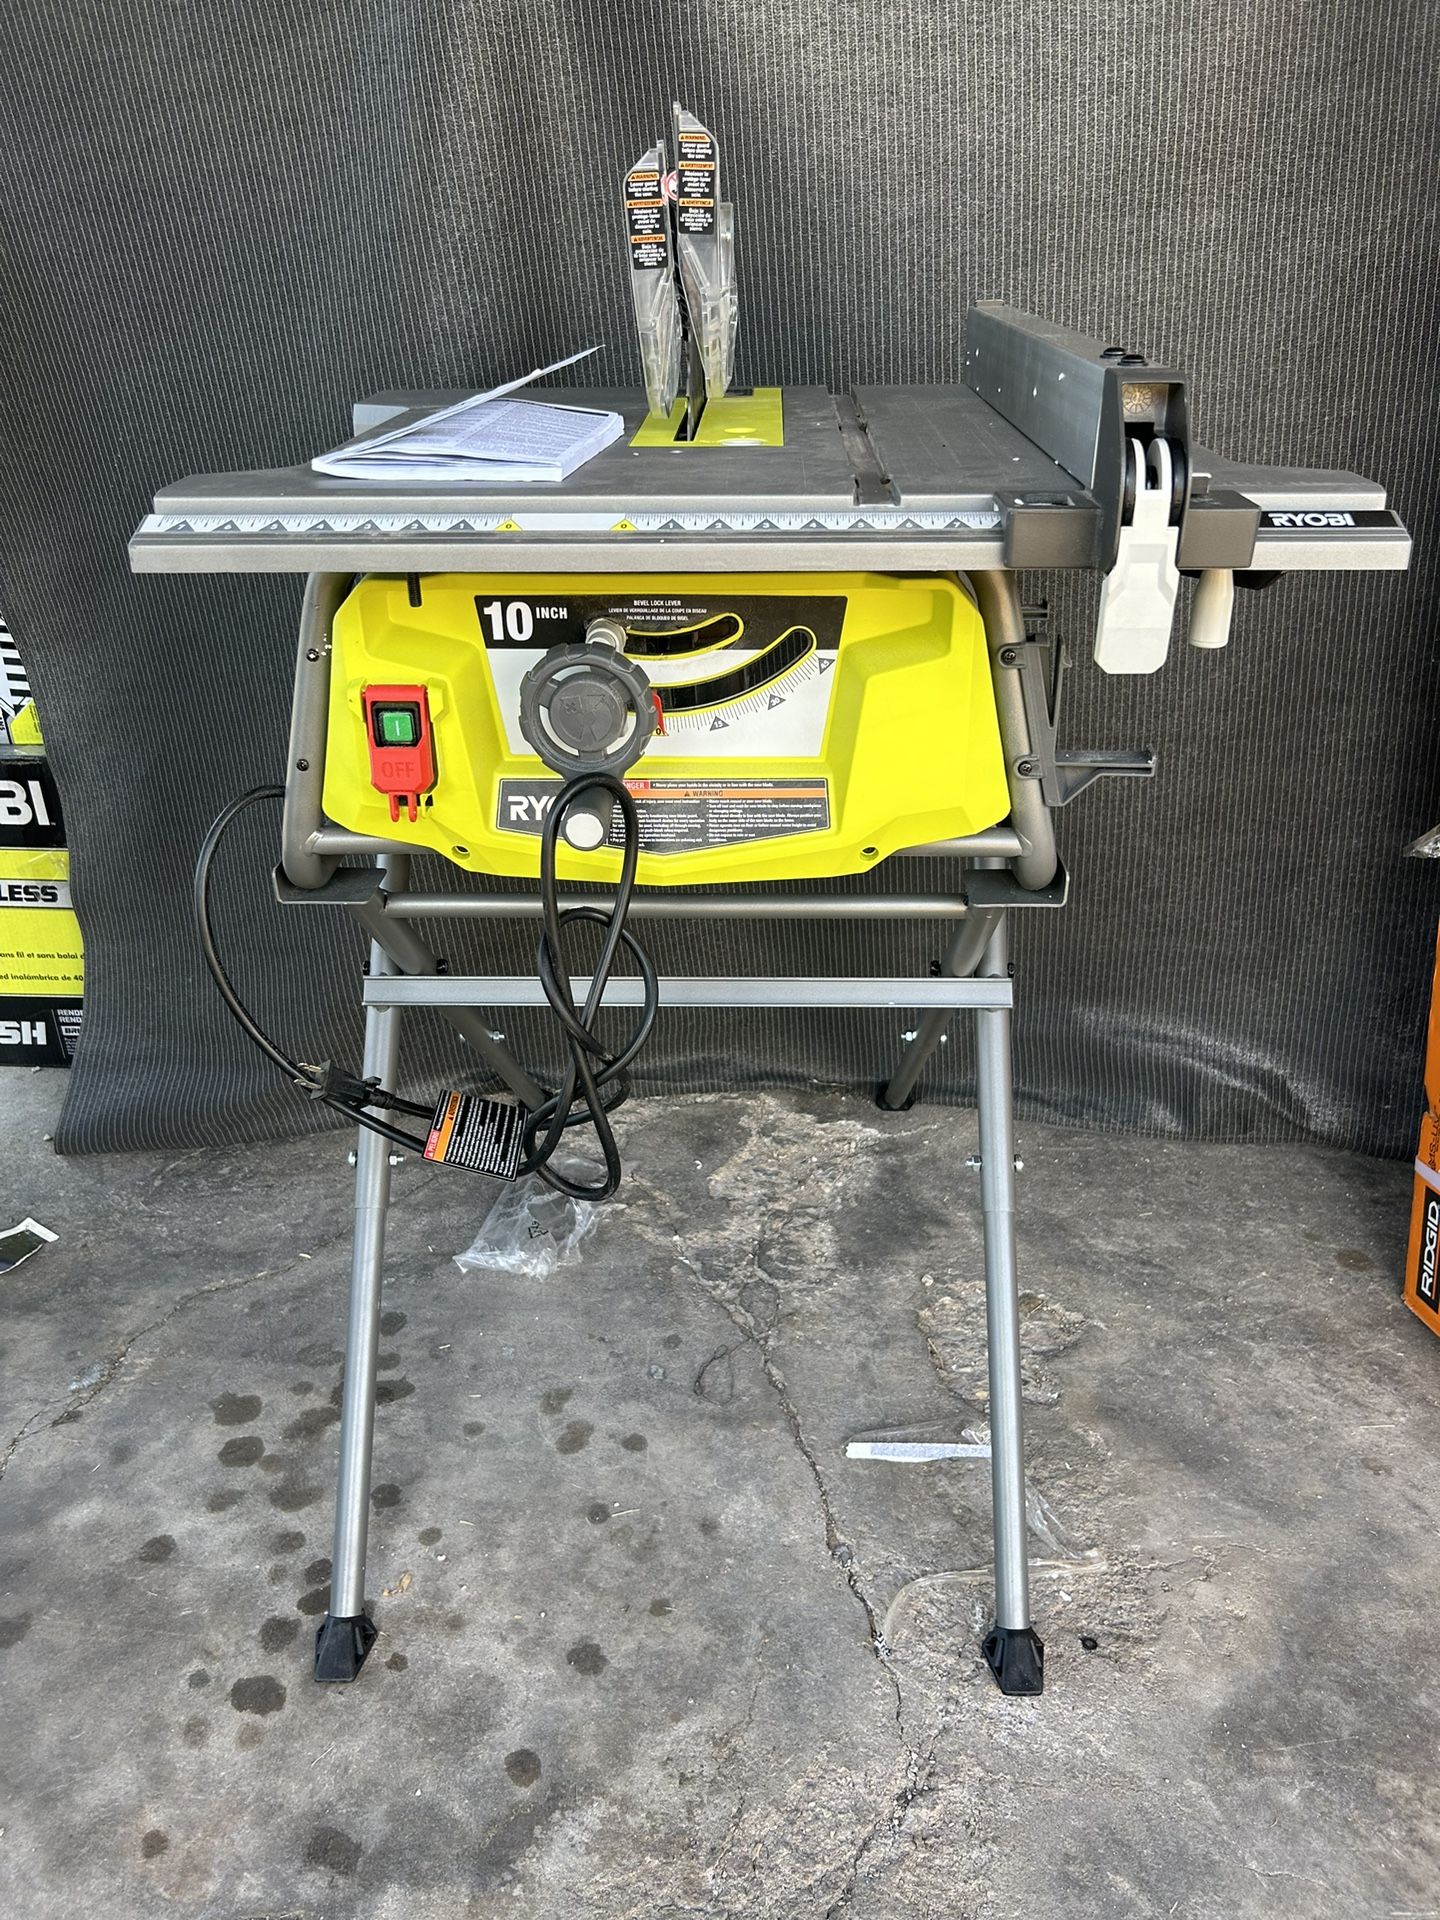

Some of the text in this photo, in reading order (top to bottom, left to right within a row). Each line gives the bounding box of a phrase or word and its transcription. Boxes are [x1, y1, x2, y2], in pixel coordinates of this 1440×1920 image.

[1268, 513, 1356, 527] RYOBI
[483, 601, 568, 641] 10 INCH
[655, 727, 662, 736] 0
[382, 762, 415, 778] OFF
[1421, 1201, 1439, 1297] RIDGID
